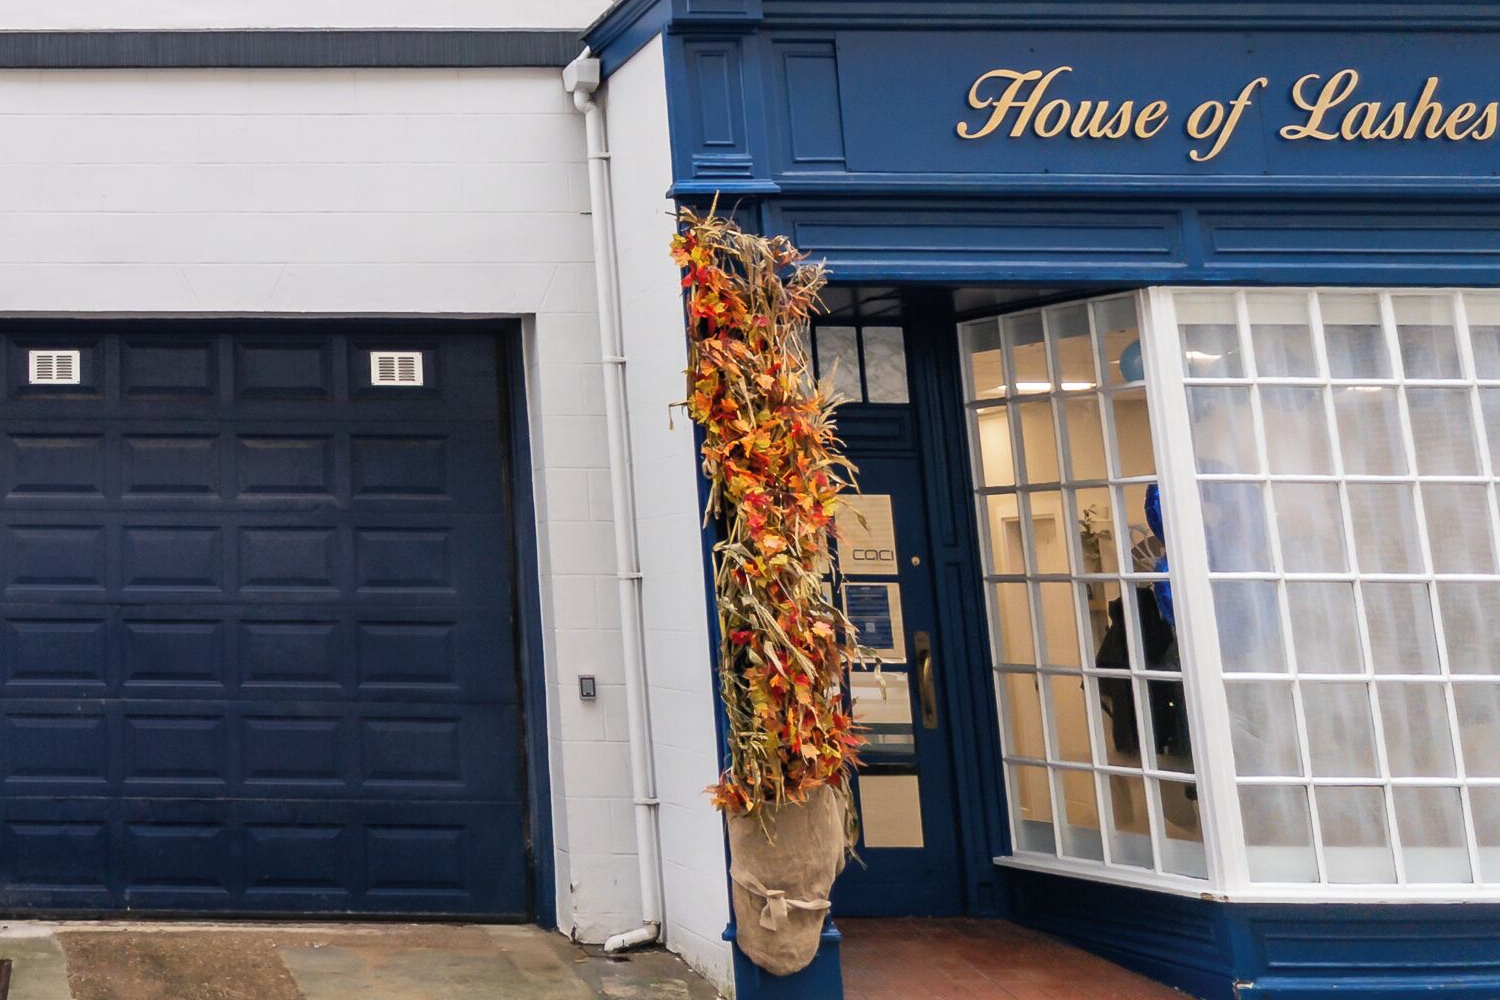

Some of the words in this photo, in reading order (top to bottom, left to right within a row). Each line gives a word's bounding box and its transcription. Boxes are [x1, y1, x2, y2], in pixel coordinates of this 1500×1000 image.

[956, 66, 1169, 140] House
[1186, 76, 1268, 162] of
[1279, 68, 1499, 141] Lashes
